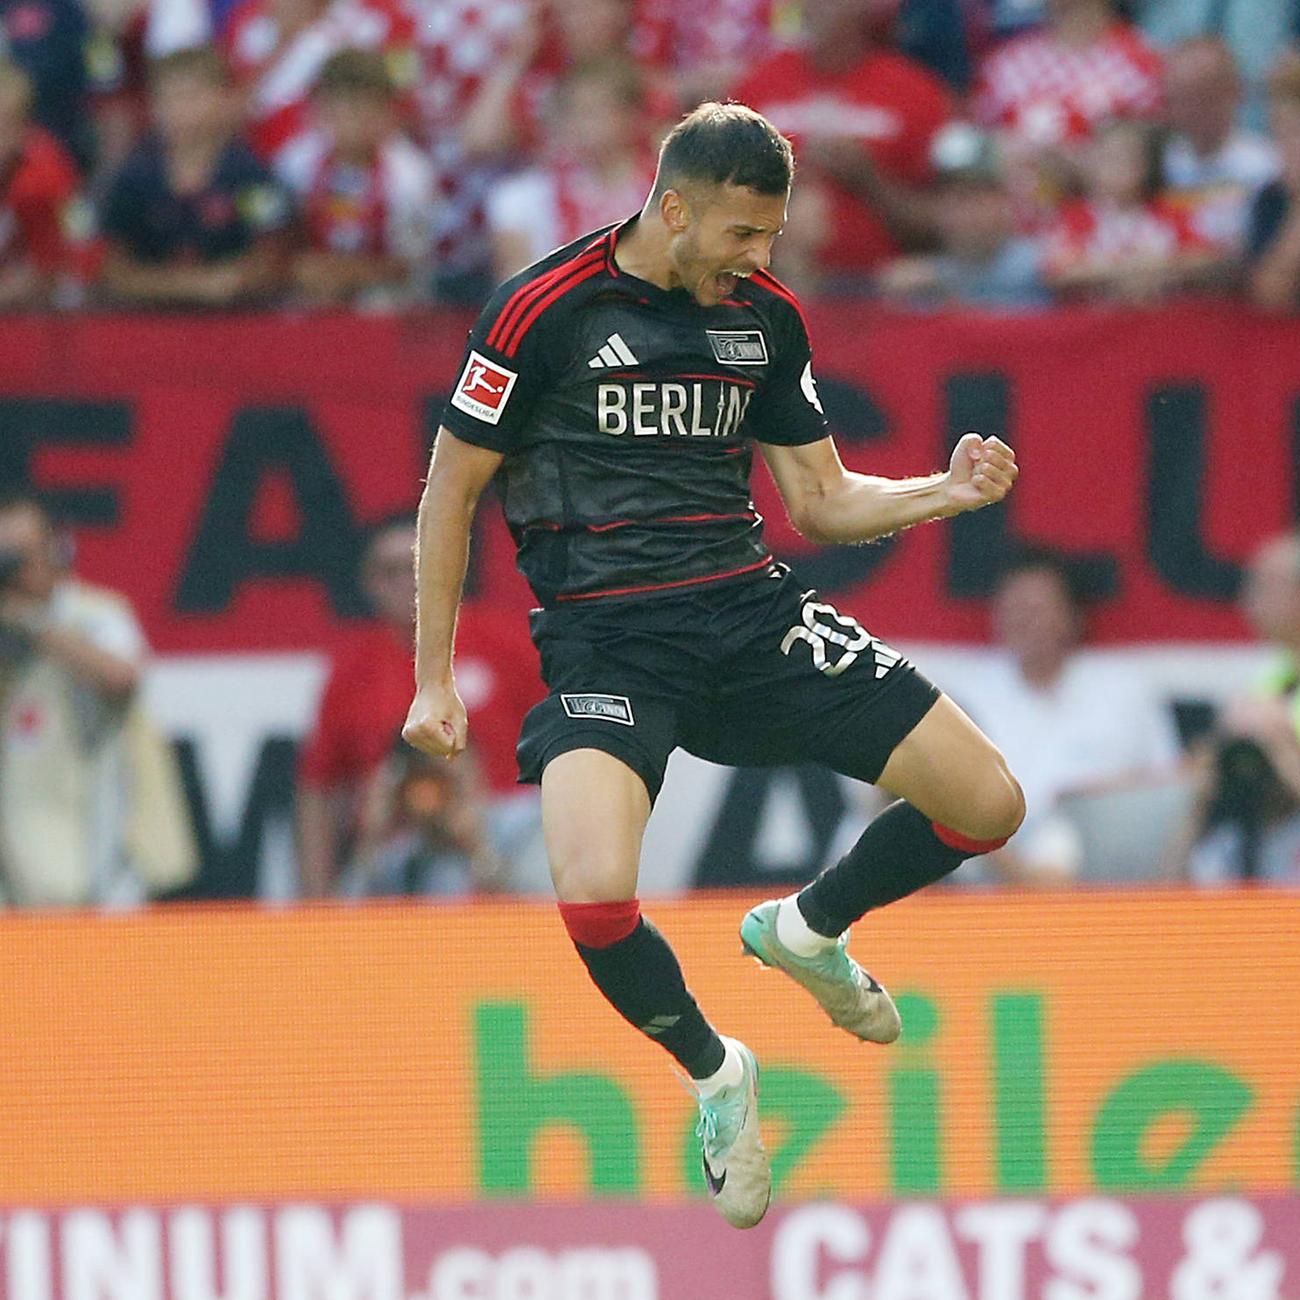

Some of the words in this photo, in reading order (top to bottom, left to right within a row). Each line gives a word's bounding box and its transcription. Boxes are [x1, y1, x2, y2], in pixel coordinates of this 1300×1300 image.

[598, 381, 754, 437] BERLIN
[780, 602, 872, 677] 20
[0, 1205, 656, 1299] INUM.com
[770, 1199, 1143, 1299] CATS
[1171, 1199, 1286, 1299] &
